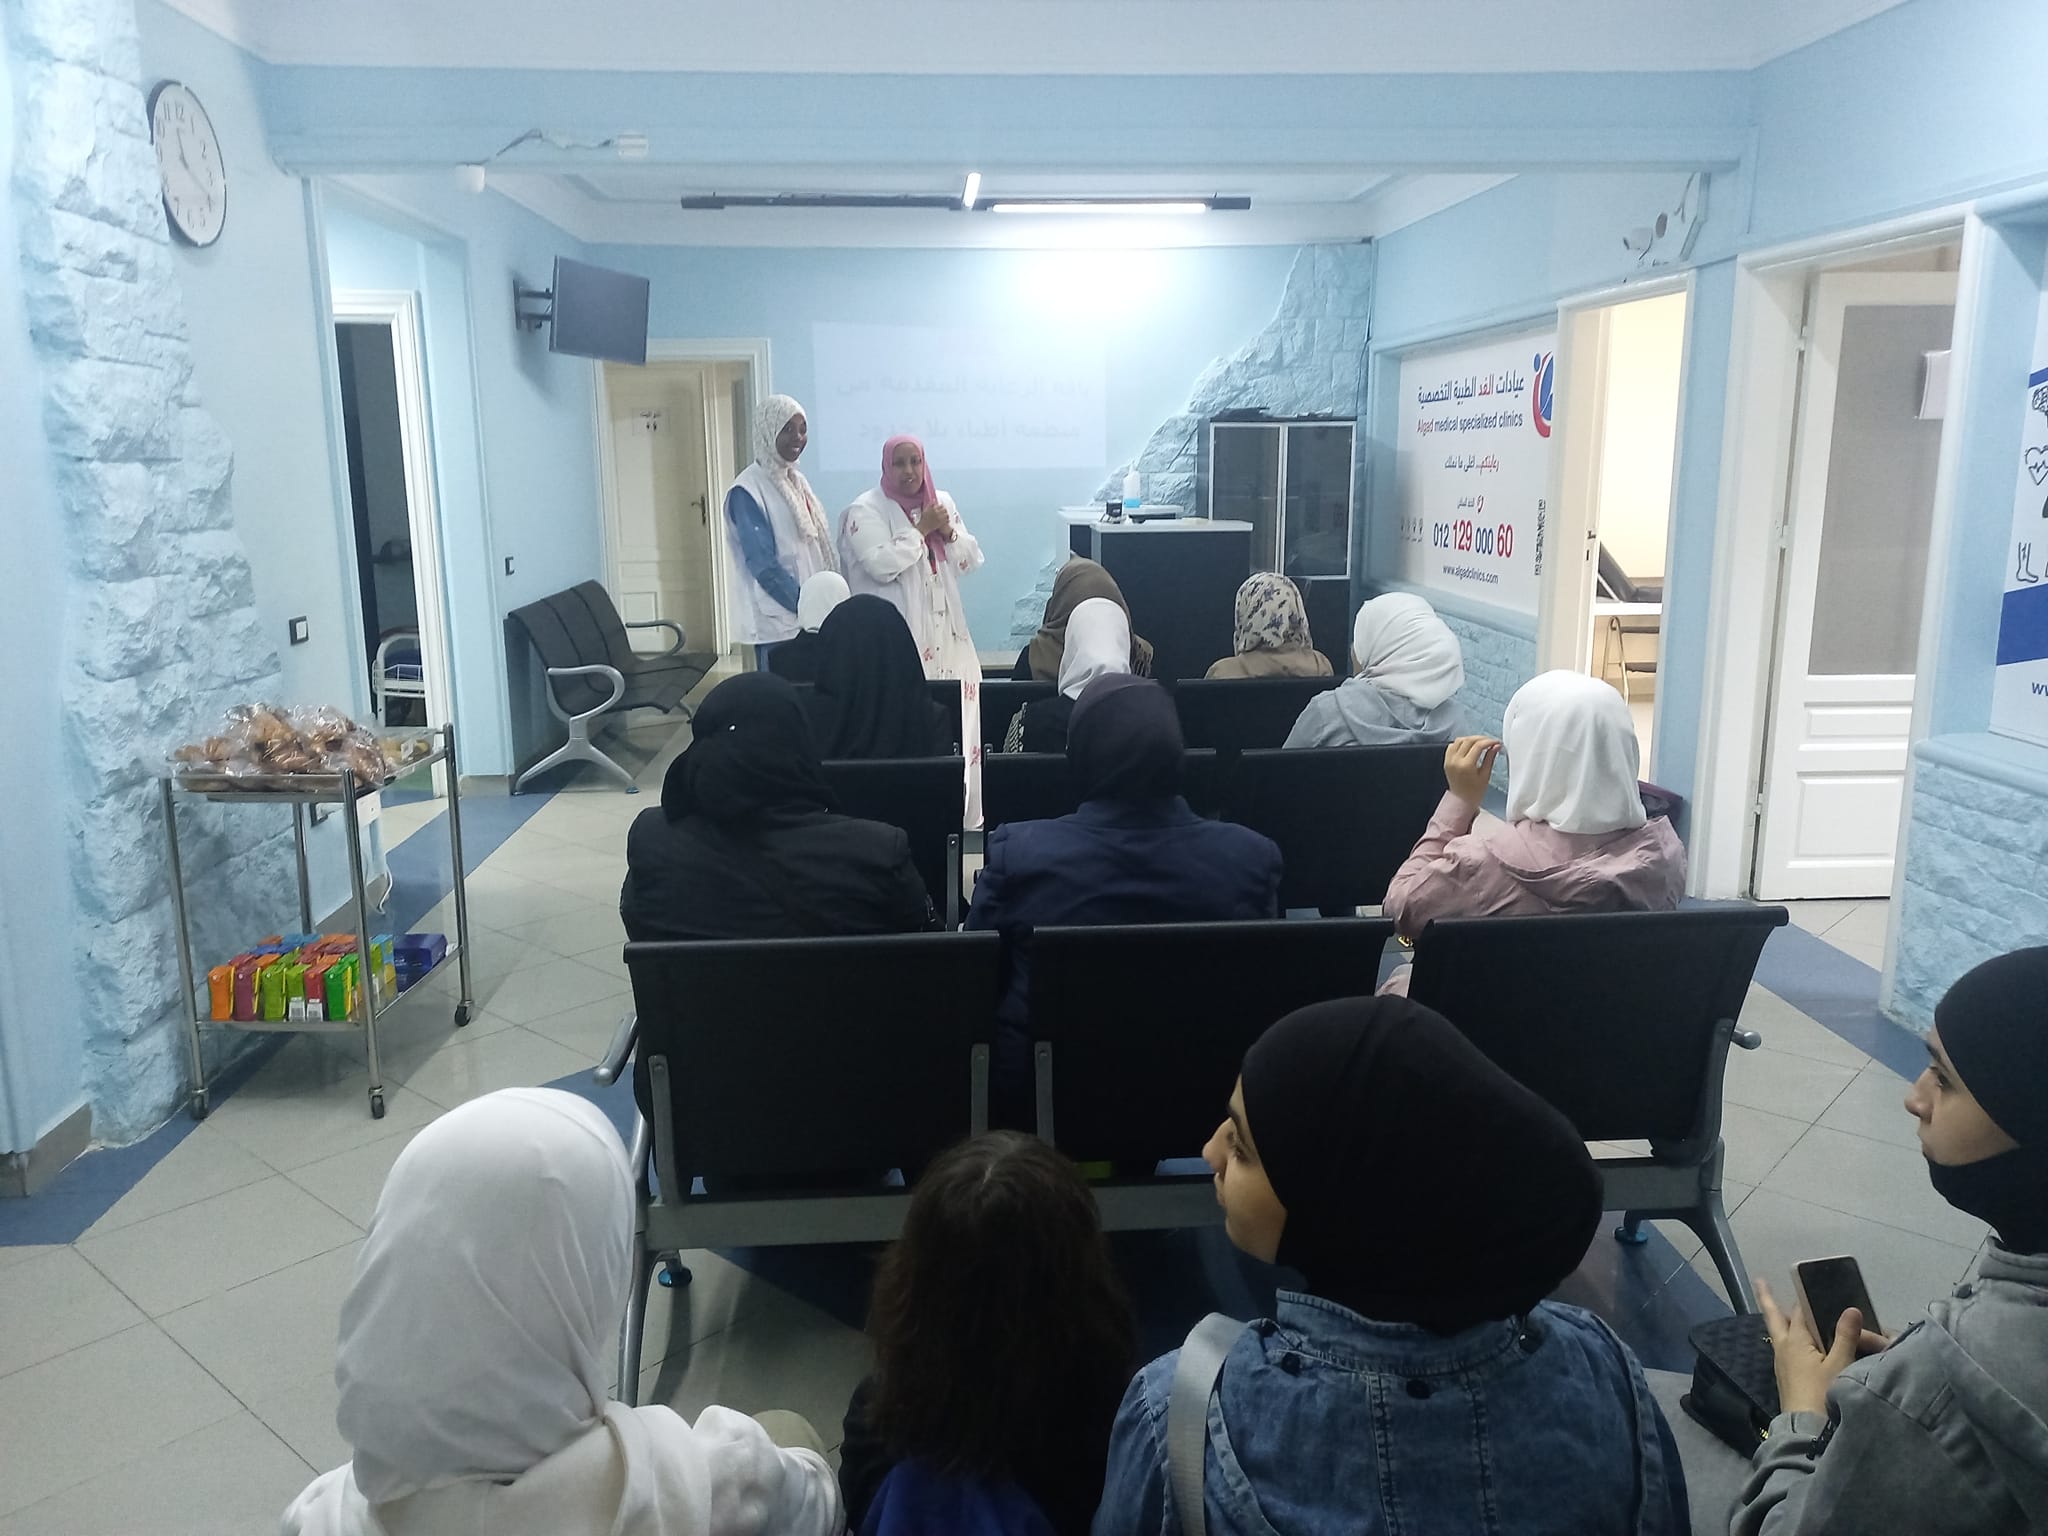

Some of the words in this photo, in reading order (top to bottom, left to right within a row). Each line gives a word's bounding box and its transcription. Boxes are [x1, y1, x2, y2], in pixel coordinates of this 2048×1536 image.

[1418, 380, 1452, 410] التخصصية
[1453, 376, 1477, 405] الطبية
[1478, 373, 1494, 397] الغد
[1495, 369, 1524, 399] عيادات
[1417, 417, 1433, 436] Algad
[1434, 415, 1458, 432] medical
[1459, 411, 1497, 434] specialized
[1498, 408, 1523, 428] clinics
[1433, 522, 1449, 548] 012
[1453, 519, 1472, 552] 129
[1475, 526, 1494, 555] 000
[1497, 523, 1513, 558] 60
[1443, 565, 1499, 584] www.algadclinics.com
